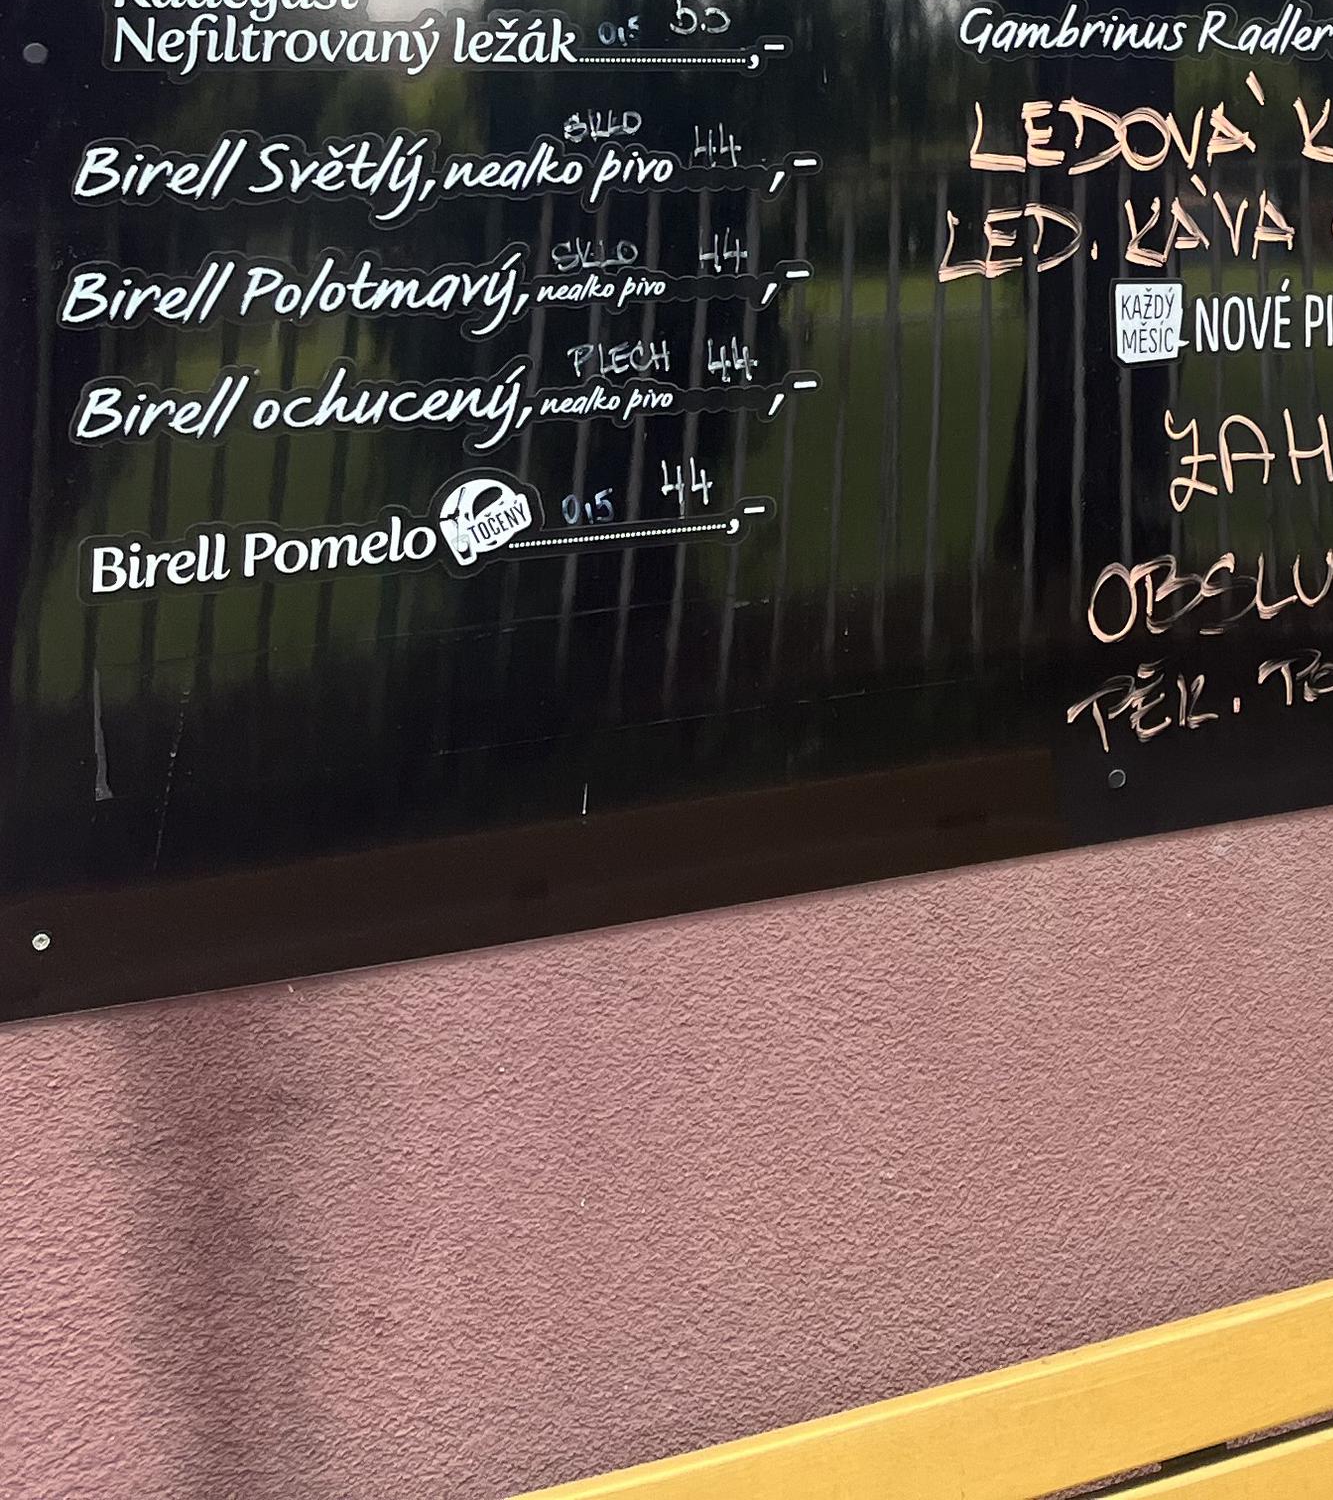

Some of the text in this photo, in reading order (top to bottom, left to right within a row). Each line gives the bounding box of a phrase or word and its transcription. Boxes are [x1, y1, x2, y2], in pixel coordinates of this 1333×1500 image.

[113, 14, 578, 76] Nefiltrovaný ležák
[959, 6, 1188, 53] Gambrinus
[970, 73, 1266, 175] LEDOVÁ
[73, 136, 674, 222] Birell Světlý, nealko pivo
[698, 227, 750, 274] 44
[938, 201, 1100, 283] LED.
[1124, 176, 1297, 269] KÁVA
[61, 253, 667, 336] Birell Polotmavý, nealko pivo
[1120, 286, 1175, 323] KAŽDÝ
[1195, 278, 1292, 352] NOVÉ
[570, 339, 759, 384] PLECH 44
[1121, 320, 1175, 357] MĚSÍC
[75, 366, 674, 451] Birell ochucený, nealko pivo
[562, 457, 715, 526] 0,5 44
[89, 518, 438, 594] Birell Pomelo
